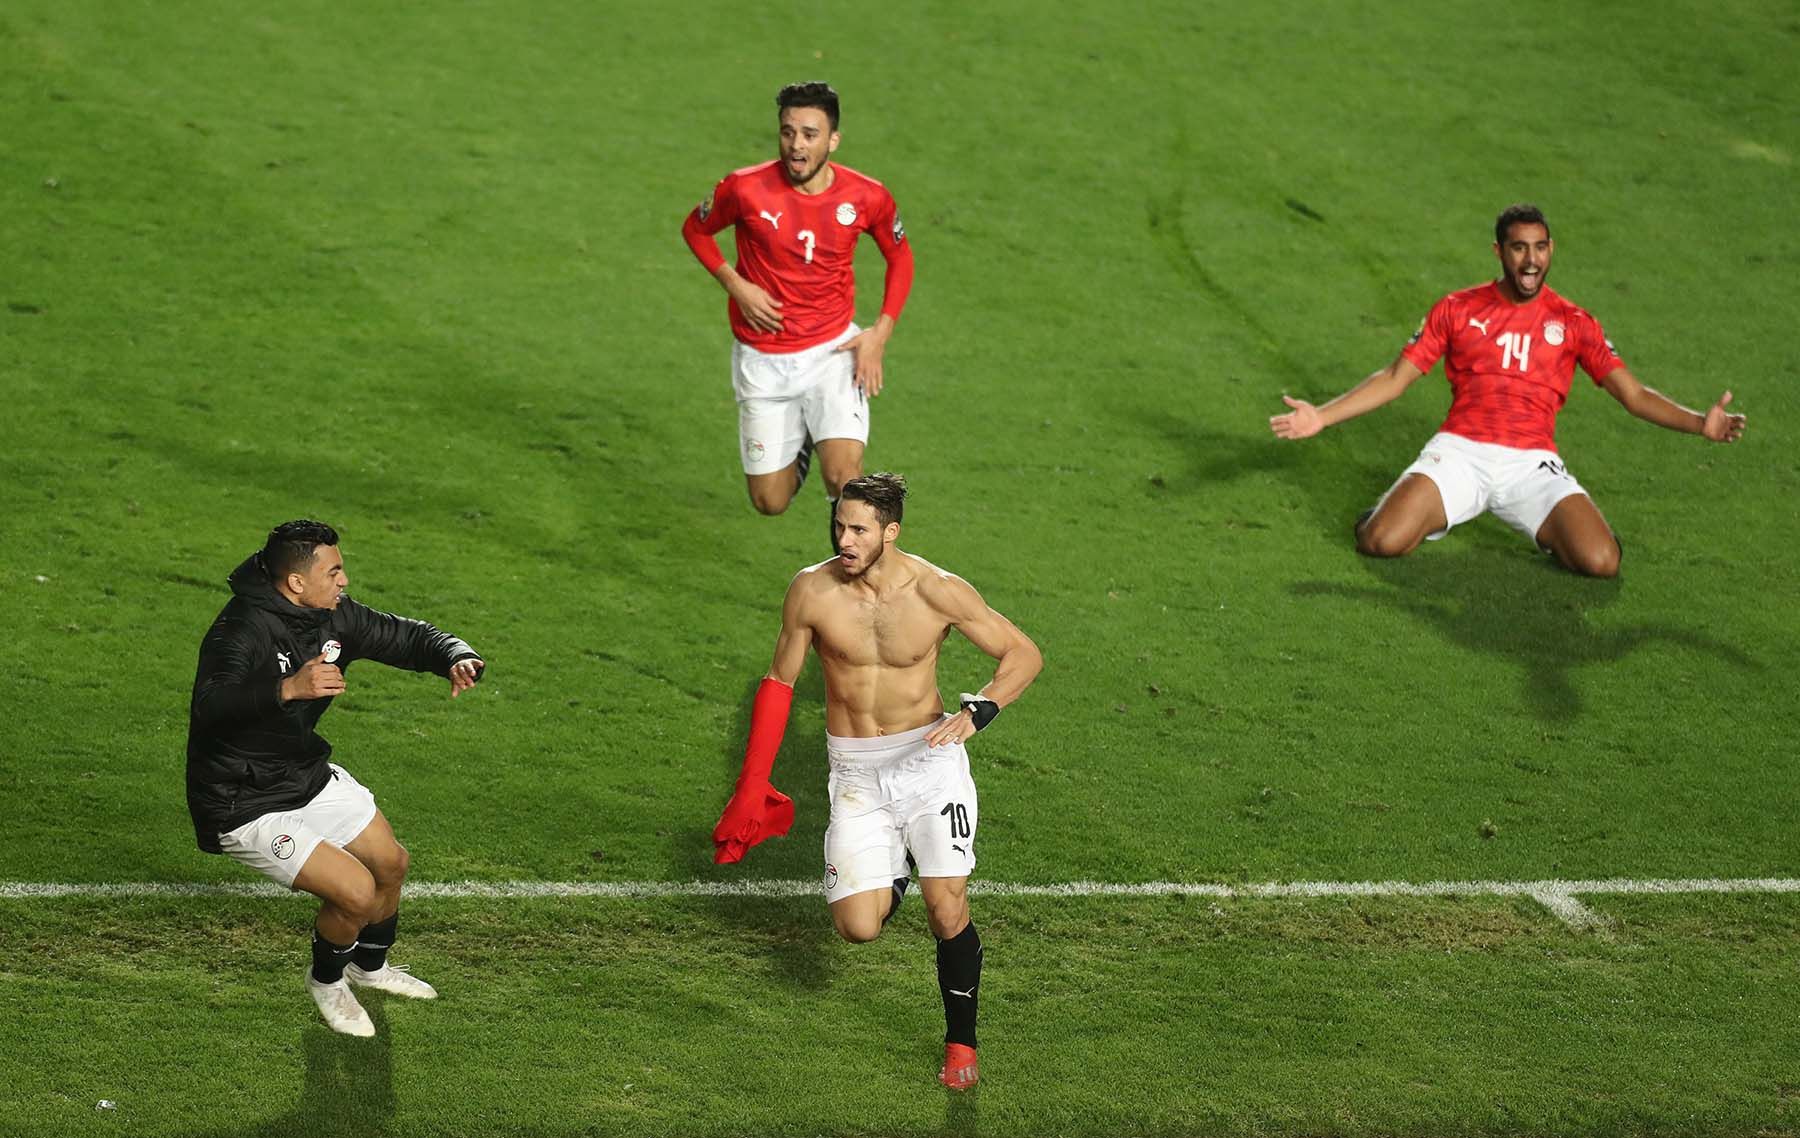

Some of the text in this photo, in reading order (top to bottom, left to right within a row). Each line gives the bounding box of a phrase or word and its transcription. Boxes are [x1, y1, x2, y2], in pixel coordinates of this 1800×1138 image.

[797, 229, 816, 264] 7
[1496, 331, 1531, 372] 14
[940, 802, 970, 838] 10
